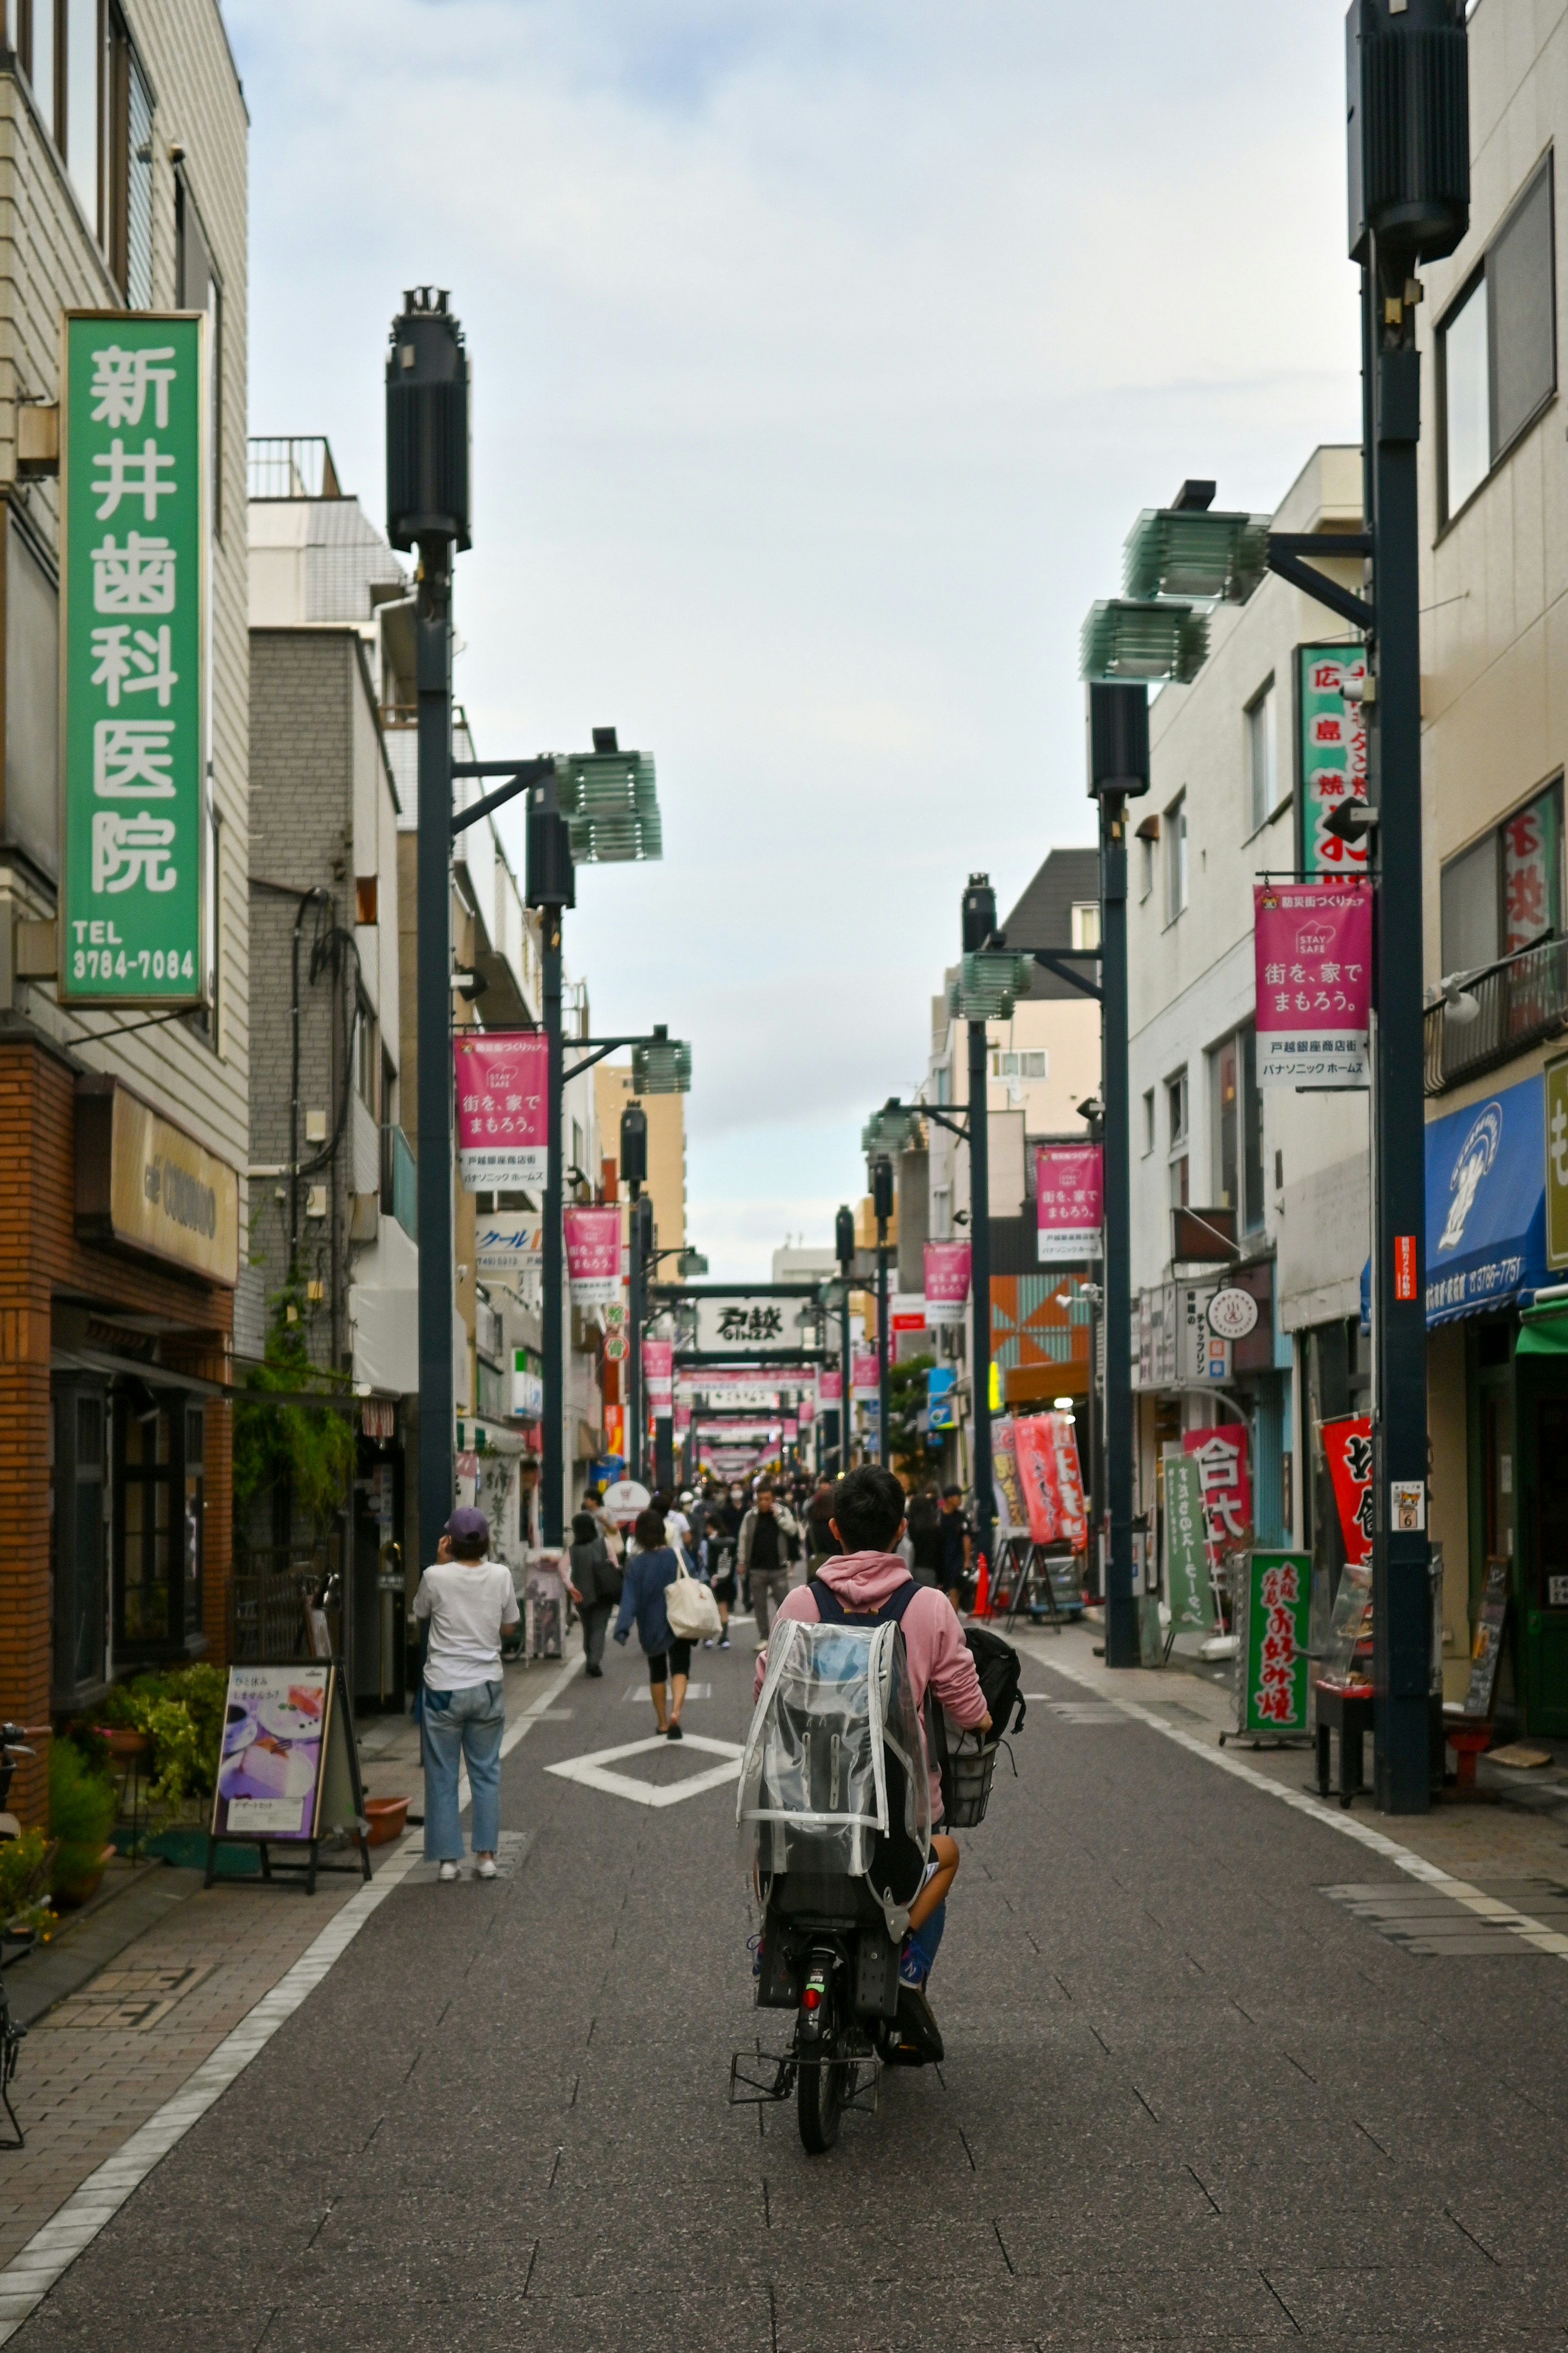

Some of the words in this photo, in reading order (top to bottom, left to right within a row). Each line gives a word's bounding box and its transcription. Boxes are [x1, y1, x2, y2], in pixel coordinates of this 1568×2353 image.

[90, 345, 178, 893] 新井歯科医院
[1282, 895, 1364, 908] 防災街づくりフェア
[73, 920, 122, 944] TEL
[1300, 936, 1325, 944] STAY
[1300, 945, 1325, 953] SAFE
[74, 950, 194, 980] 3784-7084
[1265, 962, 1363, 985] 街を、家で
[1274, 991, 1355, 1011] まもろう。
[1270, 1040, 1356, 1053] 戸越銀座商店街
[1327, 1062, 1363, 1074] ホームズ
[464, 1094, 541, 1113] 街を、家で
[471, 1117, 535, 1133] まもろう。
[1048, 1205, 1095, 1219] まもろう。
[476, 1228, 531, 1249] クール
[723, 1328, 775, 1341] GINZA
[1404, 1514, 1412, 1527] 6
[1255, 1607, 1298, 1720] お好み焼
